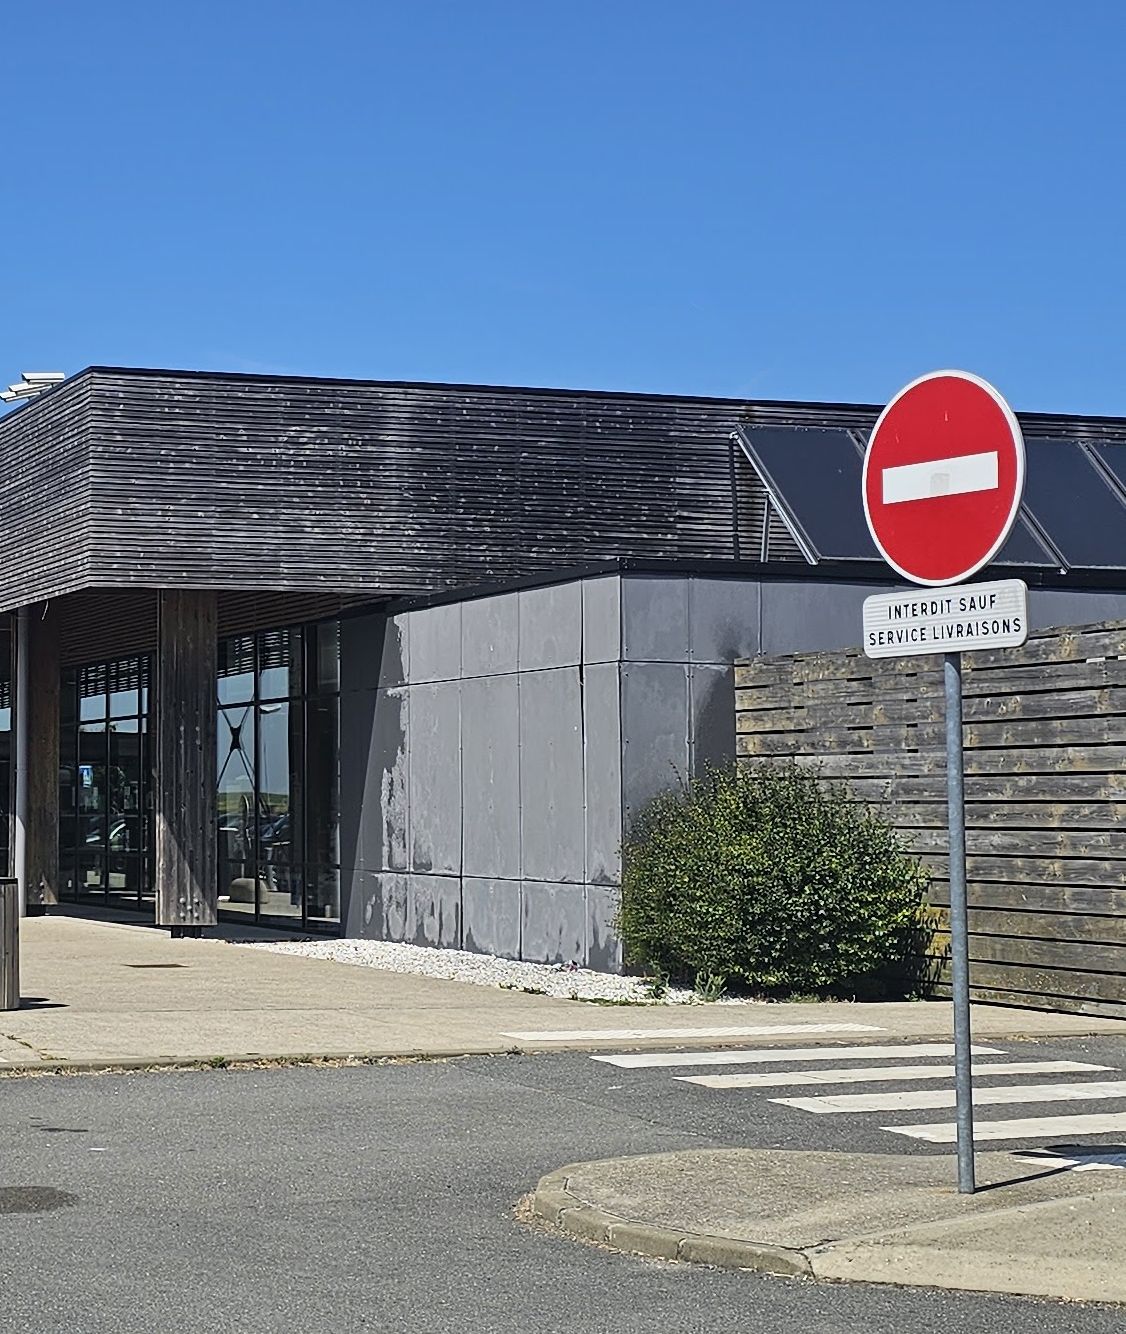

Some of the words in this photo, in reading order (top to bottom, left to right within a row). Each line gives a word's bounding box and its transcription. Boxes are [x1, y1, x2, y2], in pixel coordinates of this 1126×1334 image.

[888, 598, 952, 620] INTERDIT
[959, 593, 997, 612] SAUF
[869, 627, 927, 647] SERVICE
[933, 617, 1022, 640] LIVRAISONS
